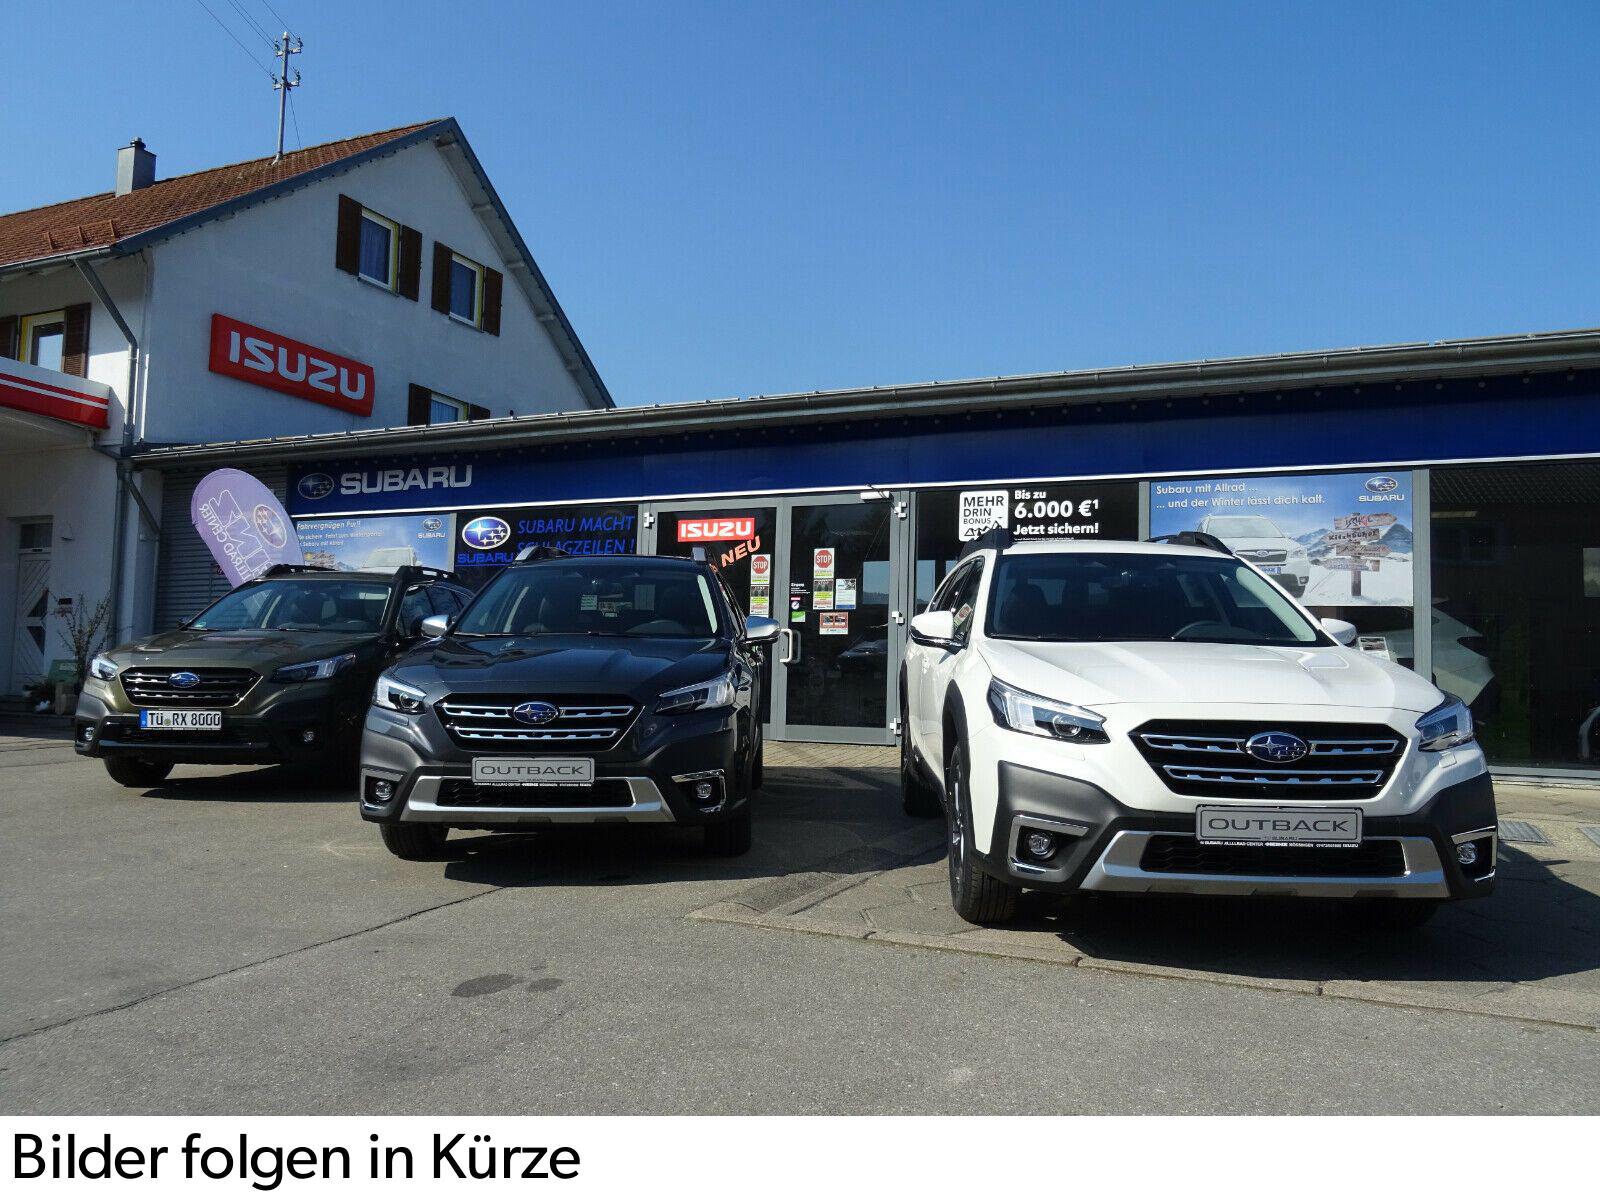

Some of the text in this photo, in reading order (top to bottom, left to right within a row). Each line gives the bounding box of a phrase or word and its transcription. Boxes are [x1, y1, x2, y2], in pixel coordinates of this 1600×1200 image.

[229, 331, 366, 401] ISUZU
[340, 464, 473, 495] SUBARU
[1014, 490, 1047, 500] Bis zu
[1156, 485, 1192, 495] Subaru
[1195, 483, 1211, 493] mit
[1214, 482, 1246, 493] Allrad
[963, 495, 1005, 507] MEHR
[1168, 499, 1188, 508] und
[1191, 498, 1208, 507] der
[1211, 497, 1244, 507] Winter
[1247, 496, 1271, 506] lässt
[1274, 495, 1298, 505] dich
[1301, 494, 1326, 504] kalt.
[1358, 494, 1405, 502] SUBARU
[963, 508, 992, 517] DRIN
[1014, 501, 1073, 519] 6.000
[518, 515, 635, 534] SUBARU MACHT
[681, 521, 751, 538] ISUZU
[1013, 522, 1099, 536] Jetzt sichern!
[457, 552, 514, 563] SUBARU
[721, 535, 761, 568] NEU
[816, 554, 832, 563] STOP
[753, 561, 768, 570] STOP
[149, 712, 220, 726] TÜ RX 8000
[480, 765, 584, 775] OUTBACK
[1208, 818, 1349, 832] OUTBACK
